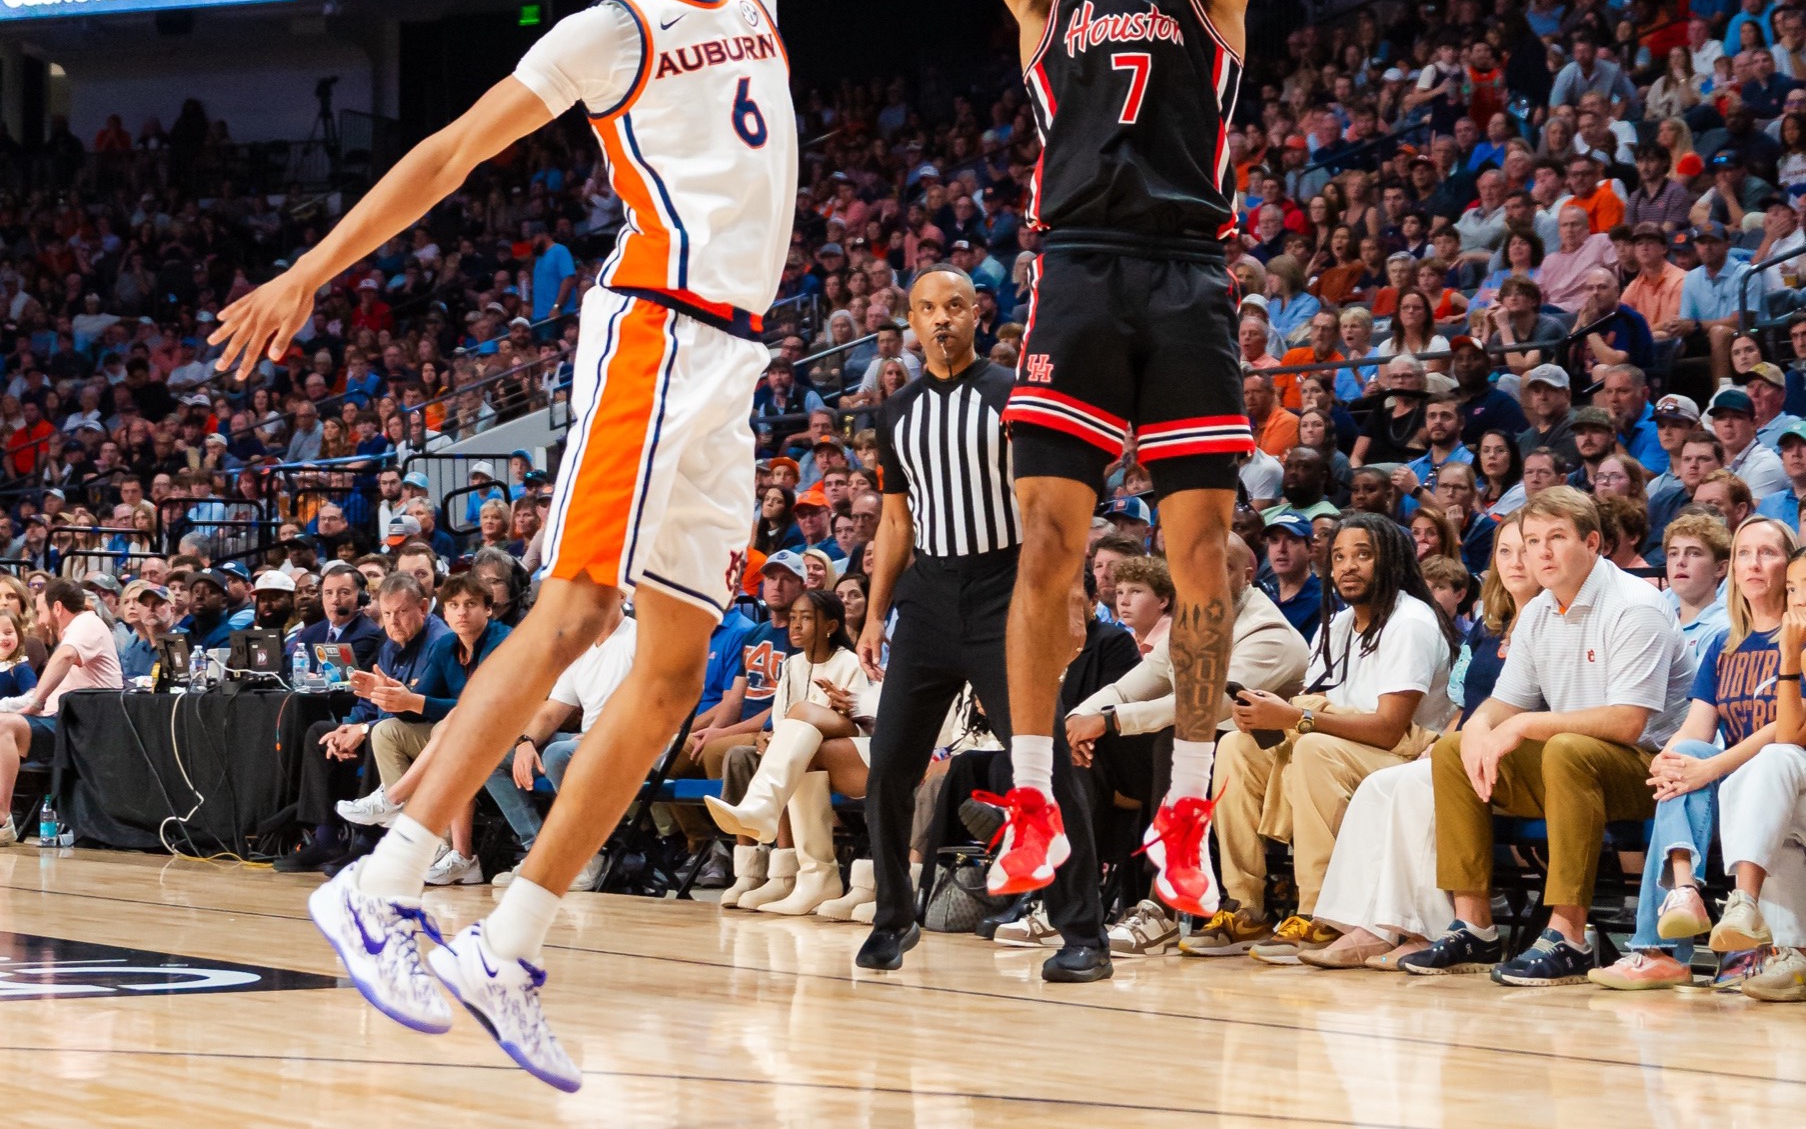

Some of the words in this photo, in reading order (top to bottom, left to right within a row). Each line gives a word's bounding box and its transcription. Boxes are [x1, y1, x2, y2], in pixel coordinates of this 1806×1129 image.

[655, 34, 777, 79] AUBURN
[1064, 0, 1184, 58] Houston
[731, 76, 768, 149] 6
[1111, 52, 1151, 124] 7
[1716, 650, 1780, 700] UBUR
